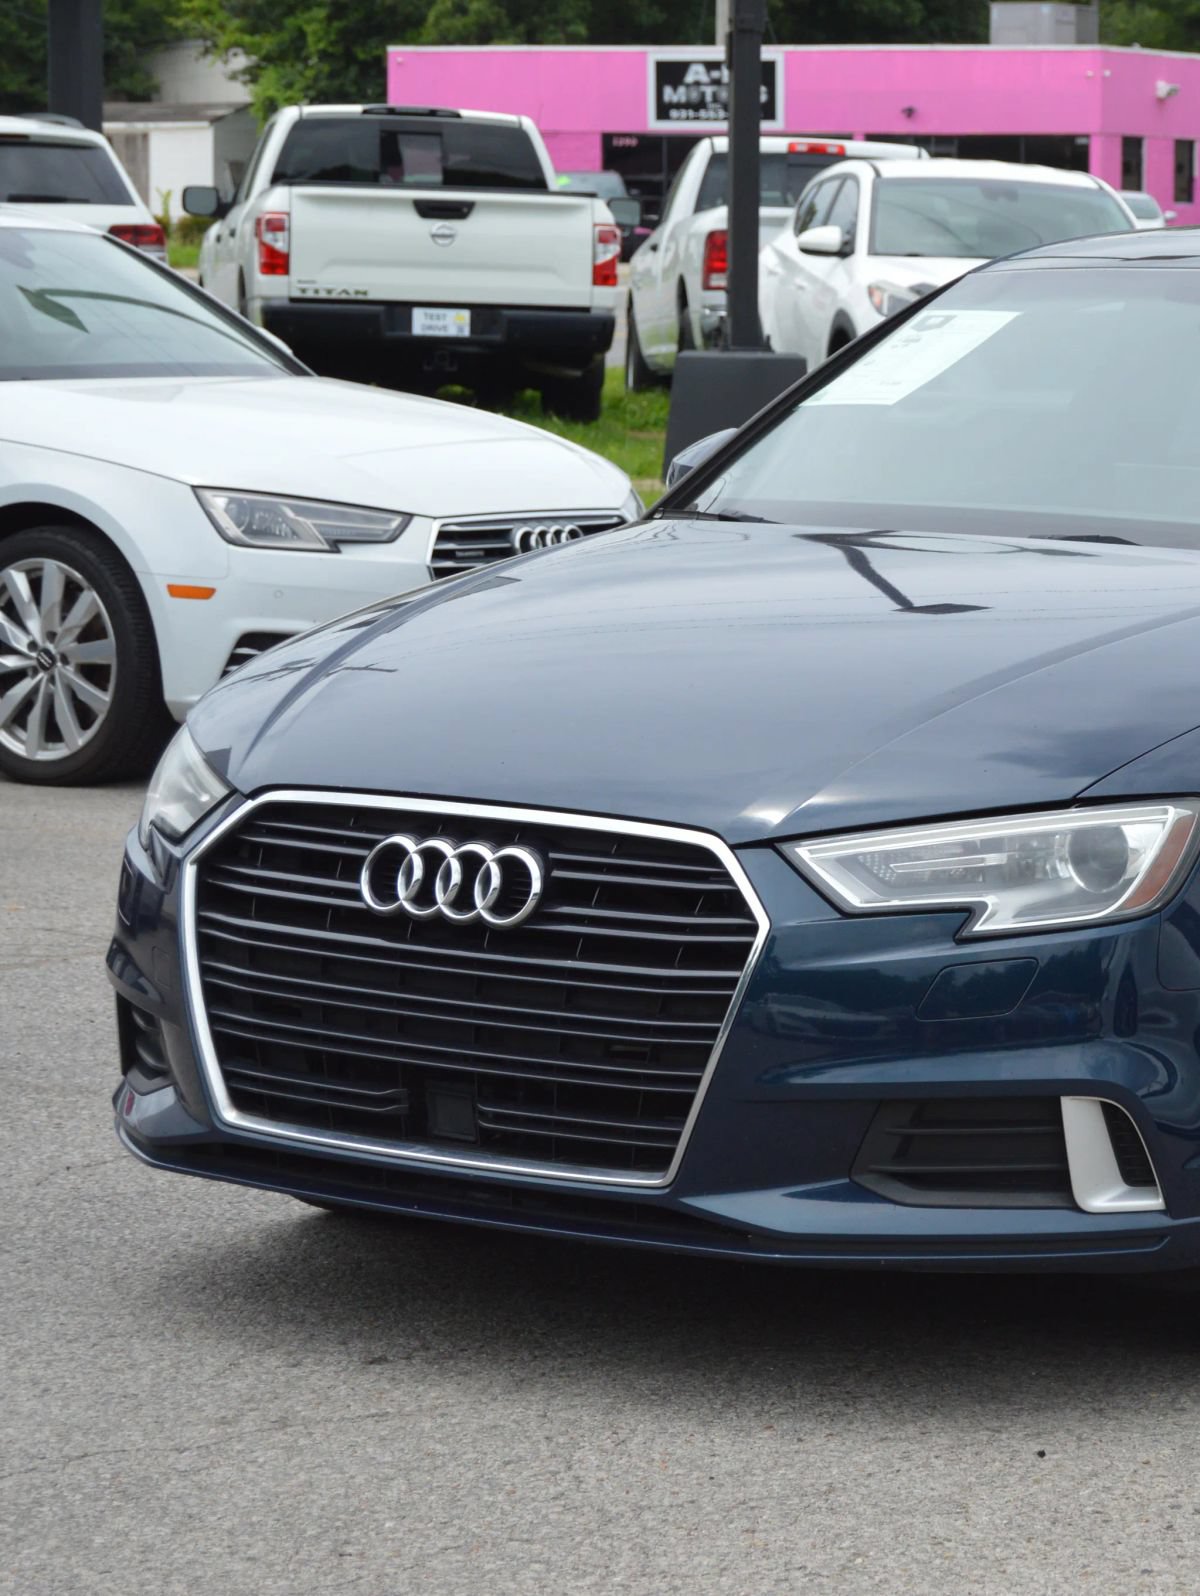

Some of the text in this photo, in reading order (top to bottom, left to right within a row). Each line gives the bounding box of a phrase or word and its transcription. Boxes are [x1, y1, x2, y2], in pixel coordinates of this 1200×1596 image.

[662, 85, 768, 103] MOTO
[298, 288, 369, 296] TITAN
[424, 312, 447, 321] TEST
